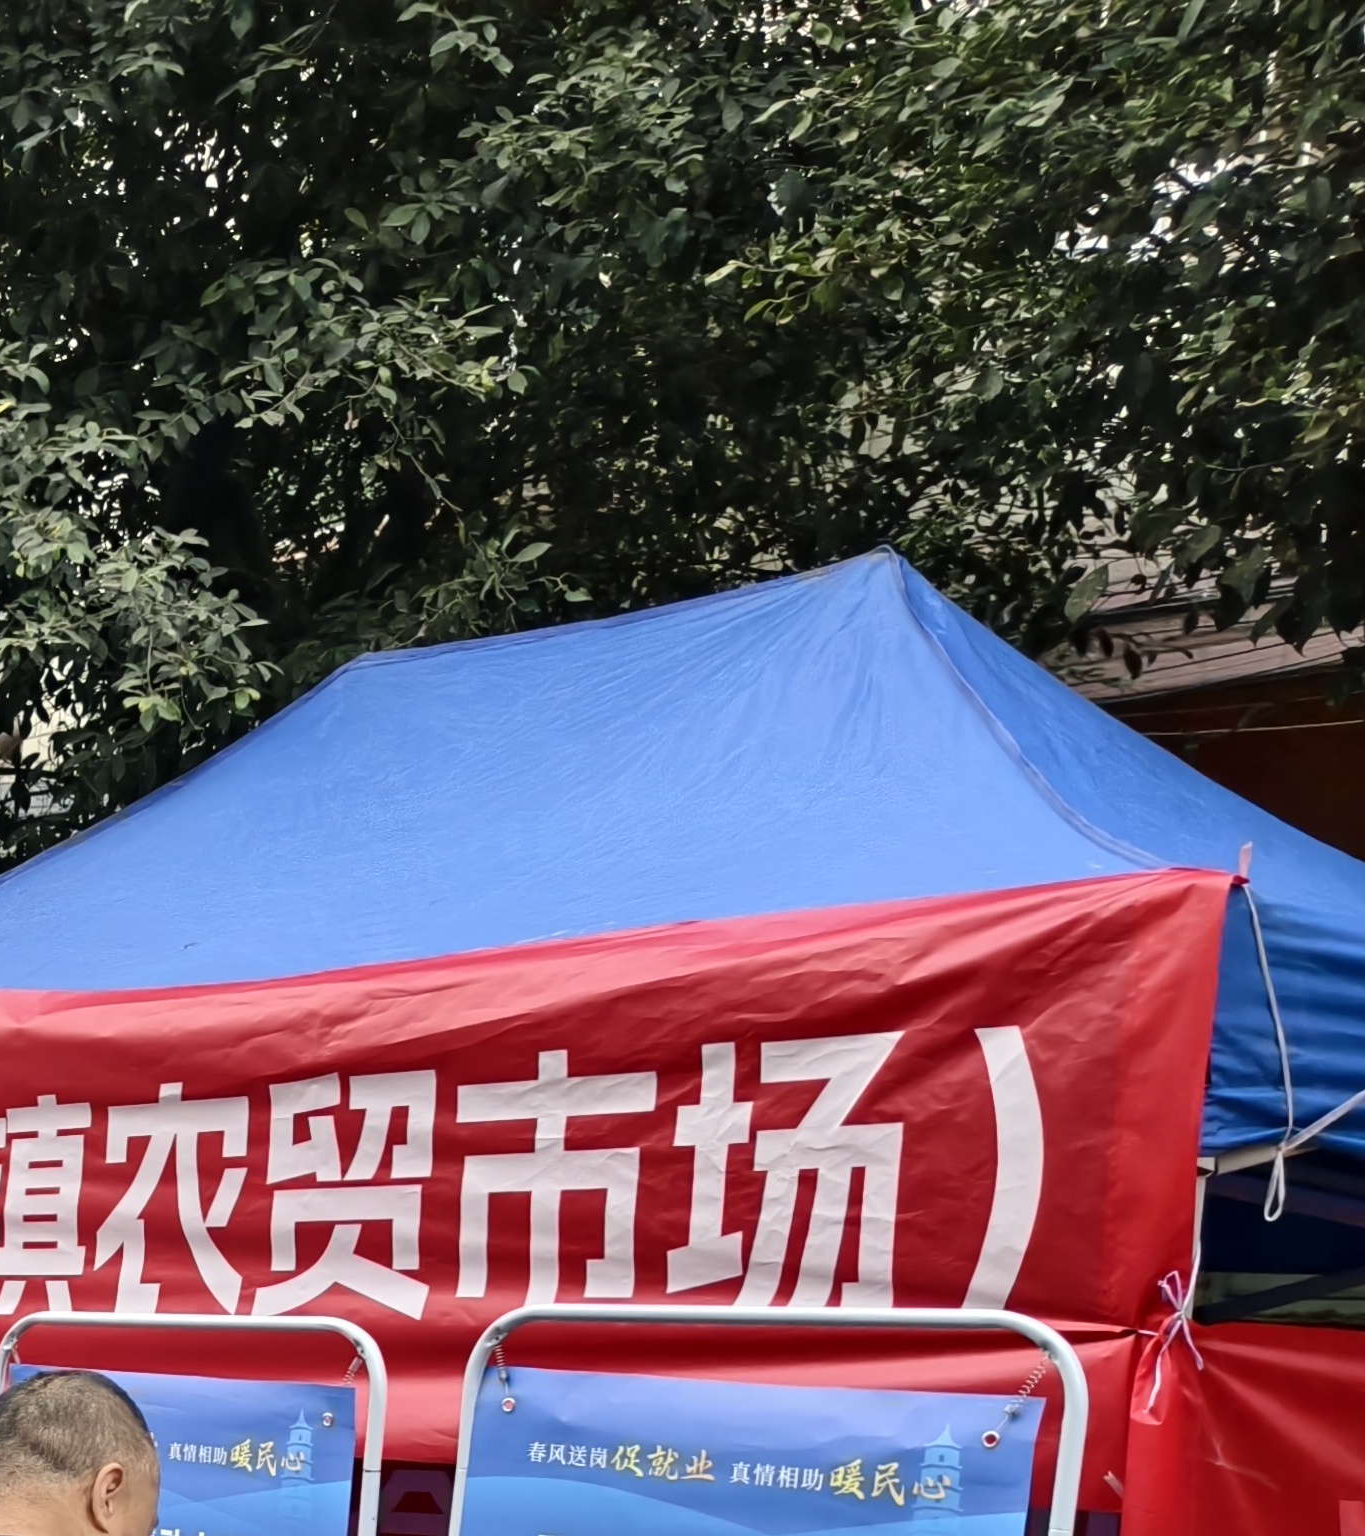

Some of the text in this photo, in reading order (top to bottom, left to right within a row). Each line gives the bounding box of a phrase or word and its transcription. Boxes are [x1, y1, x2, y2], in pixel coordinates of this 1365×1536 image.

[168, 1438, 305, 1476] 真情相助暖民心
[526, 1440, 955, 1506] 春风送岗促就业 真情相助暖民心
